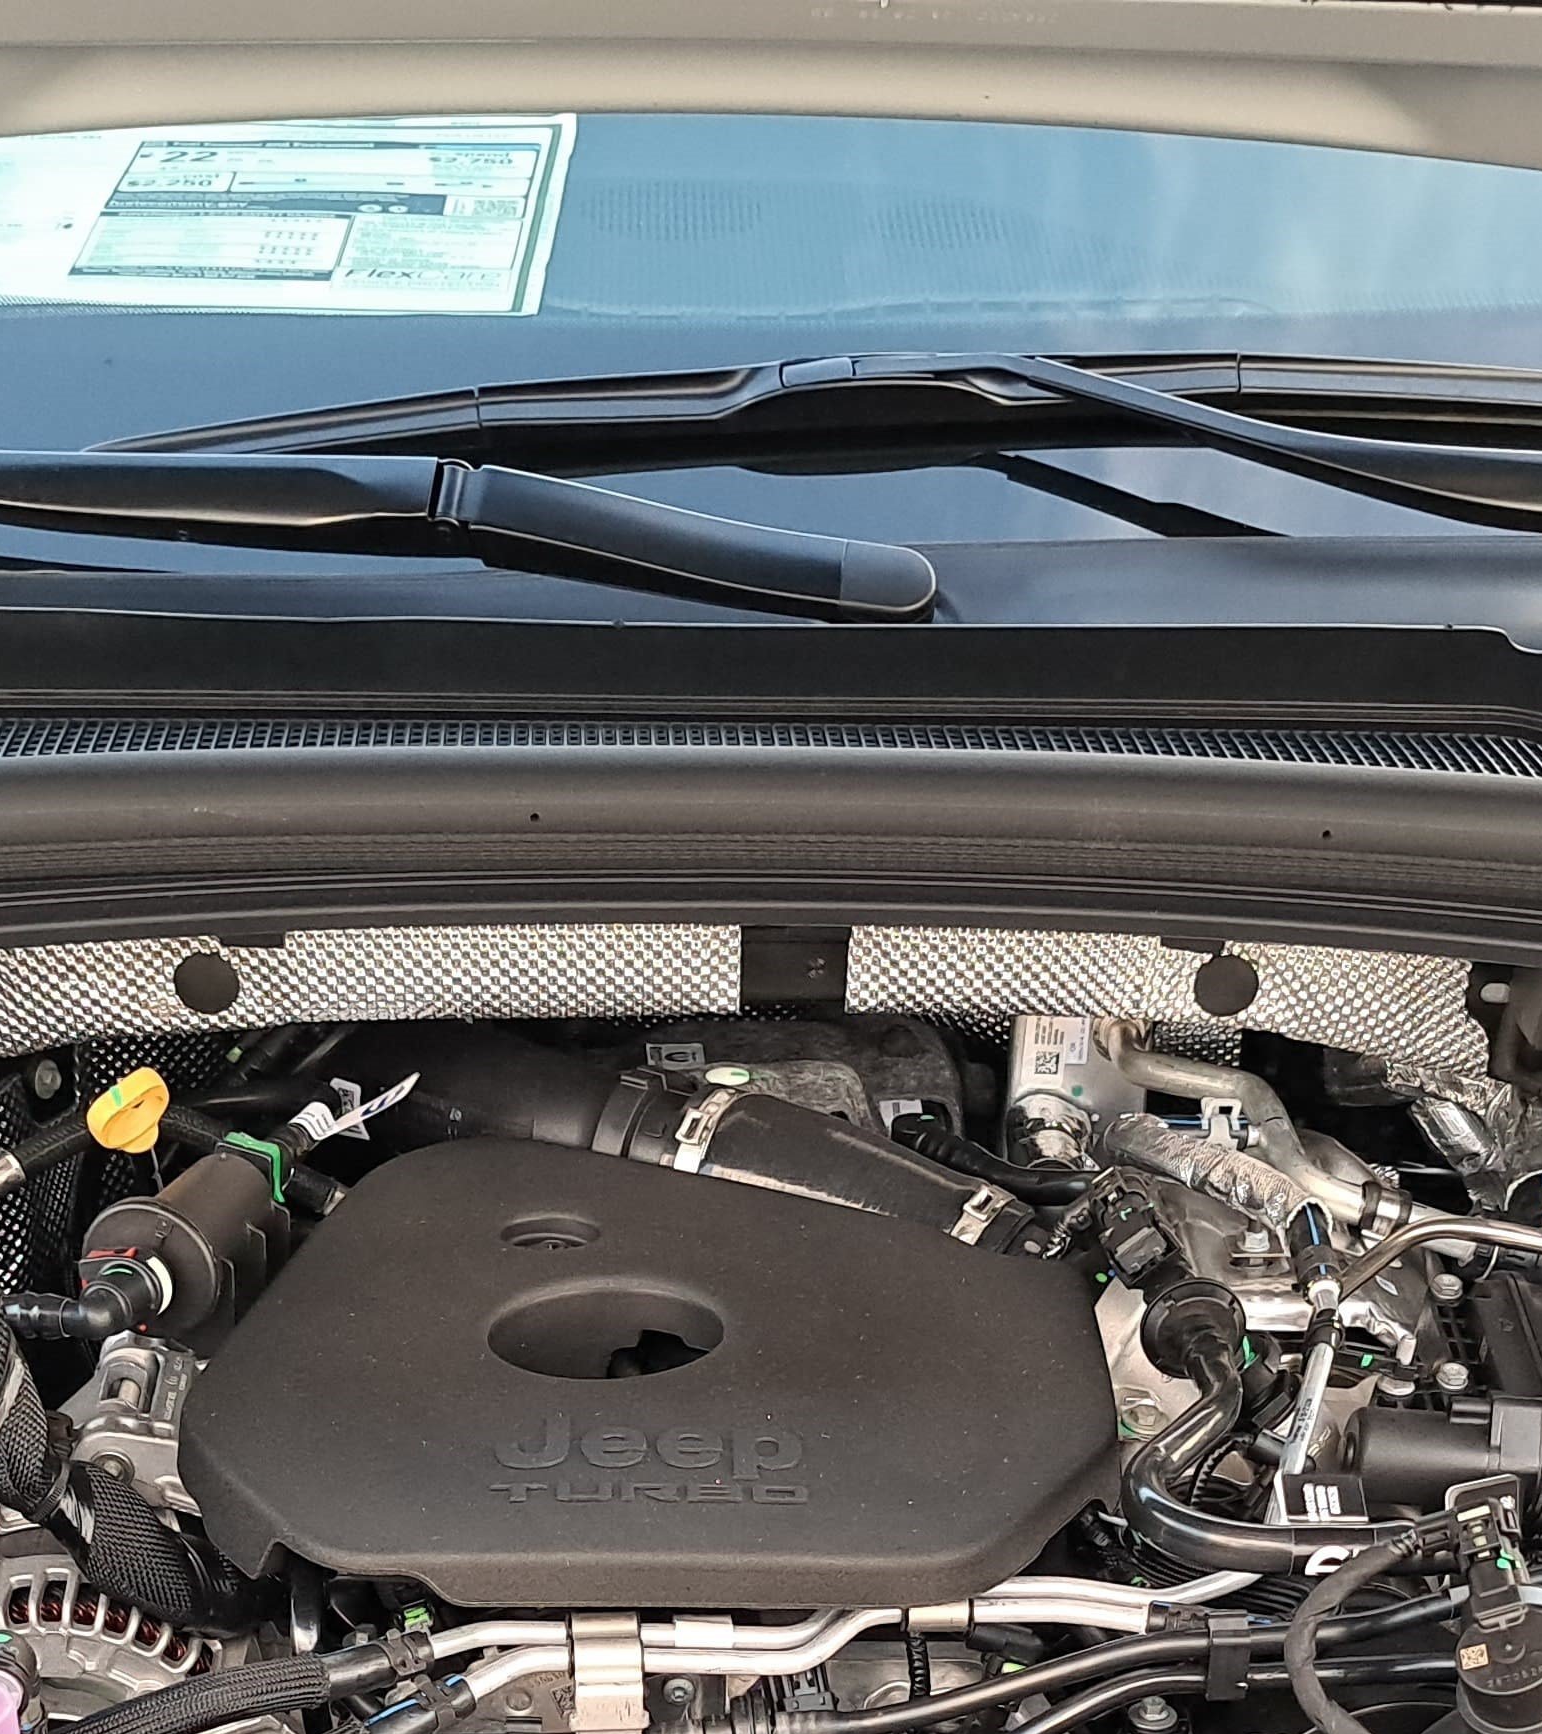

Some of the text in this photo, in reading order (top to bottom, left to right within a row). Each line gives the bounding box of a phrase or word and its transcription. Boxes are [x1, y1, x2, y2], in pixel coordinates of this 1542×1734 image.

[158, 150, 218, 163] 22
[493, 1413, 804, 1481] Jeep
[489, 1480, 809, 1504] TURBO
